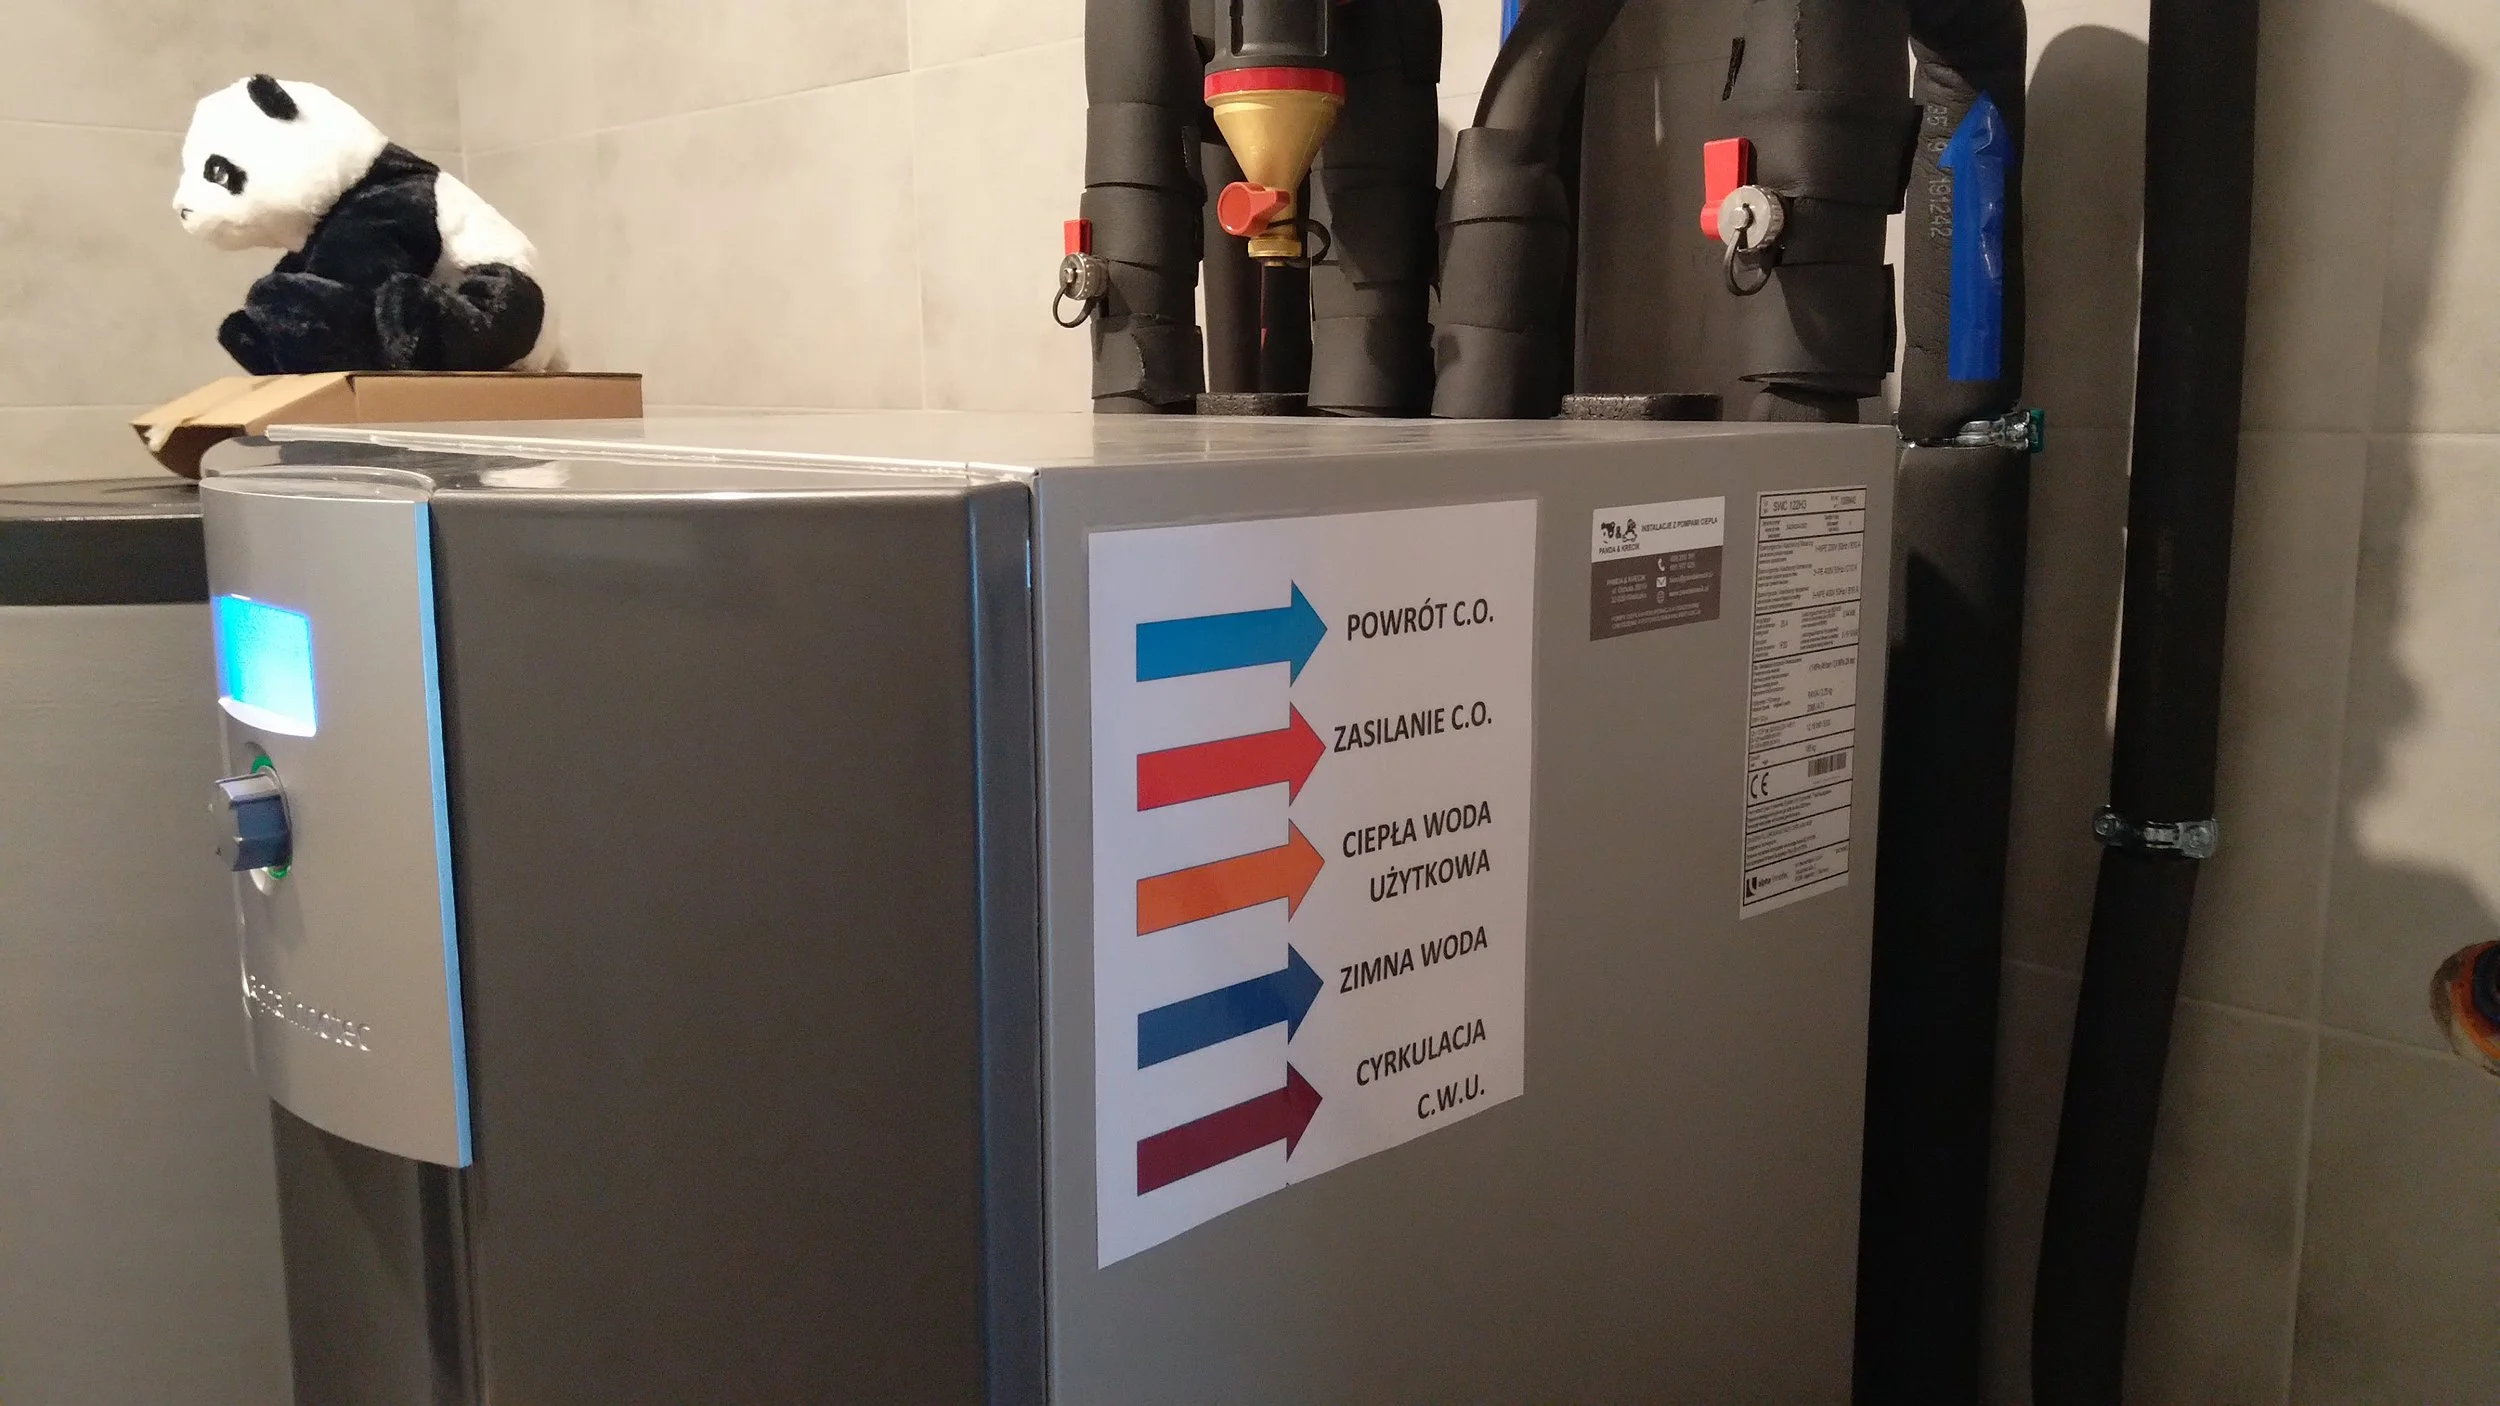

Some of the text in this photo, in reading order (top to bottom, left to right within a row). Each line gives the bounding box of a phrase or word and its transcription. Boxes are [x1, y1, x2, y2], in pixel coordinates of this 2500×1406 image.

[1347, 598, 1494, 641] POWRÓT C.O.
[1333, 701, 1492, 753] ZASILANIE C.O.
[1342, 800, 1492, 858] CIEPŁA WODA
[1370, 848, 1491, 903] UŻYTKOWA
[1339, 925, 1488, 994] ZIMNA WODA
[1356, 1018, 1486, 1087] CYRKULACJA
[1417, 1074, 1485, 1120] C.W.U.
